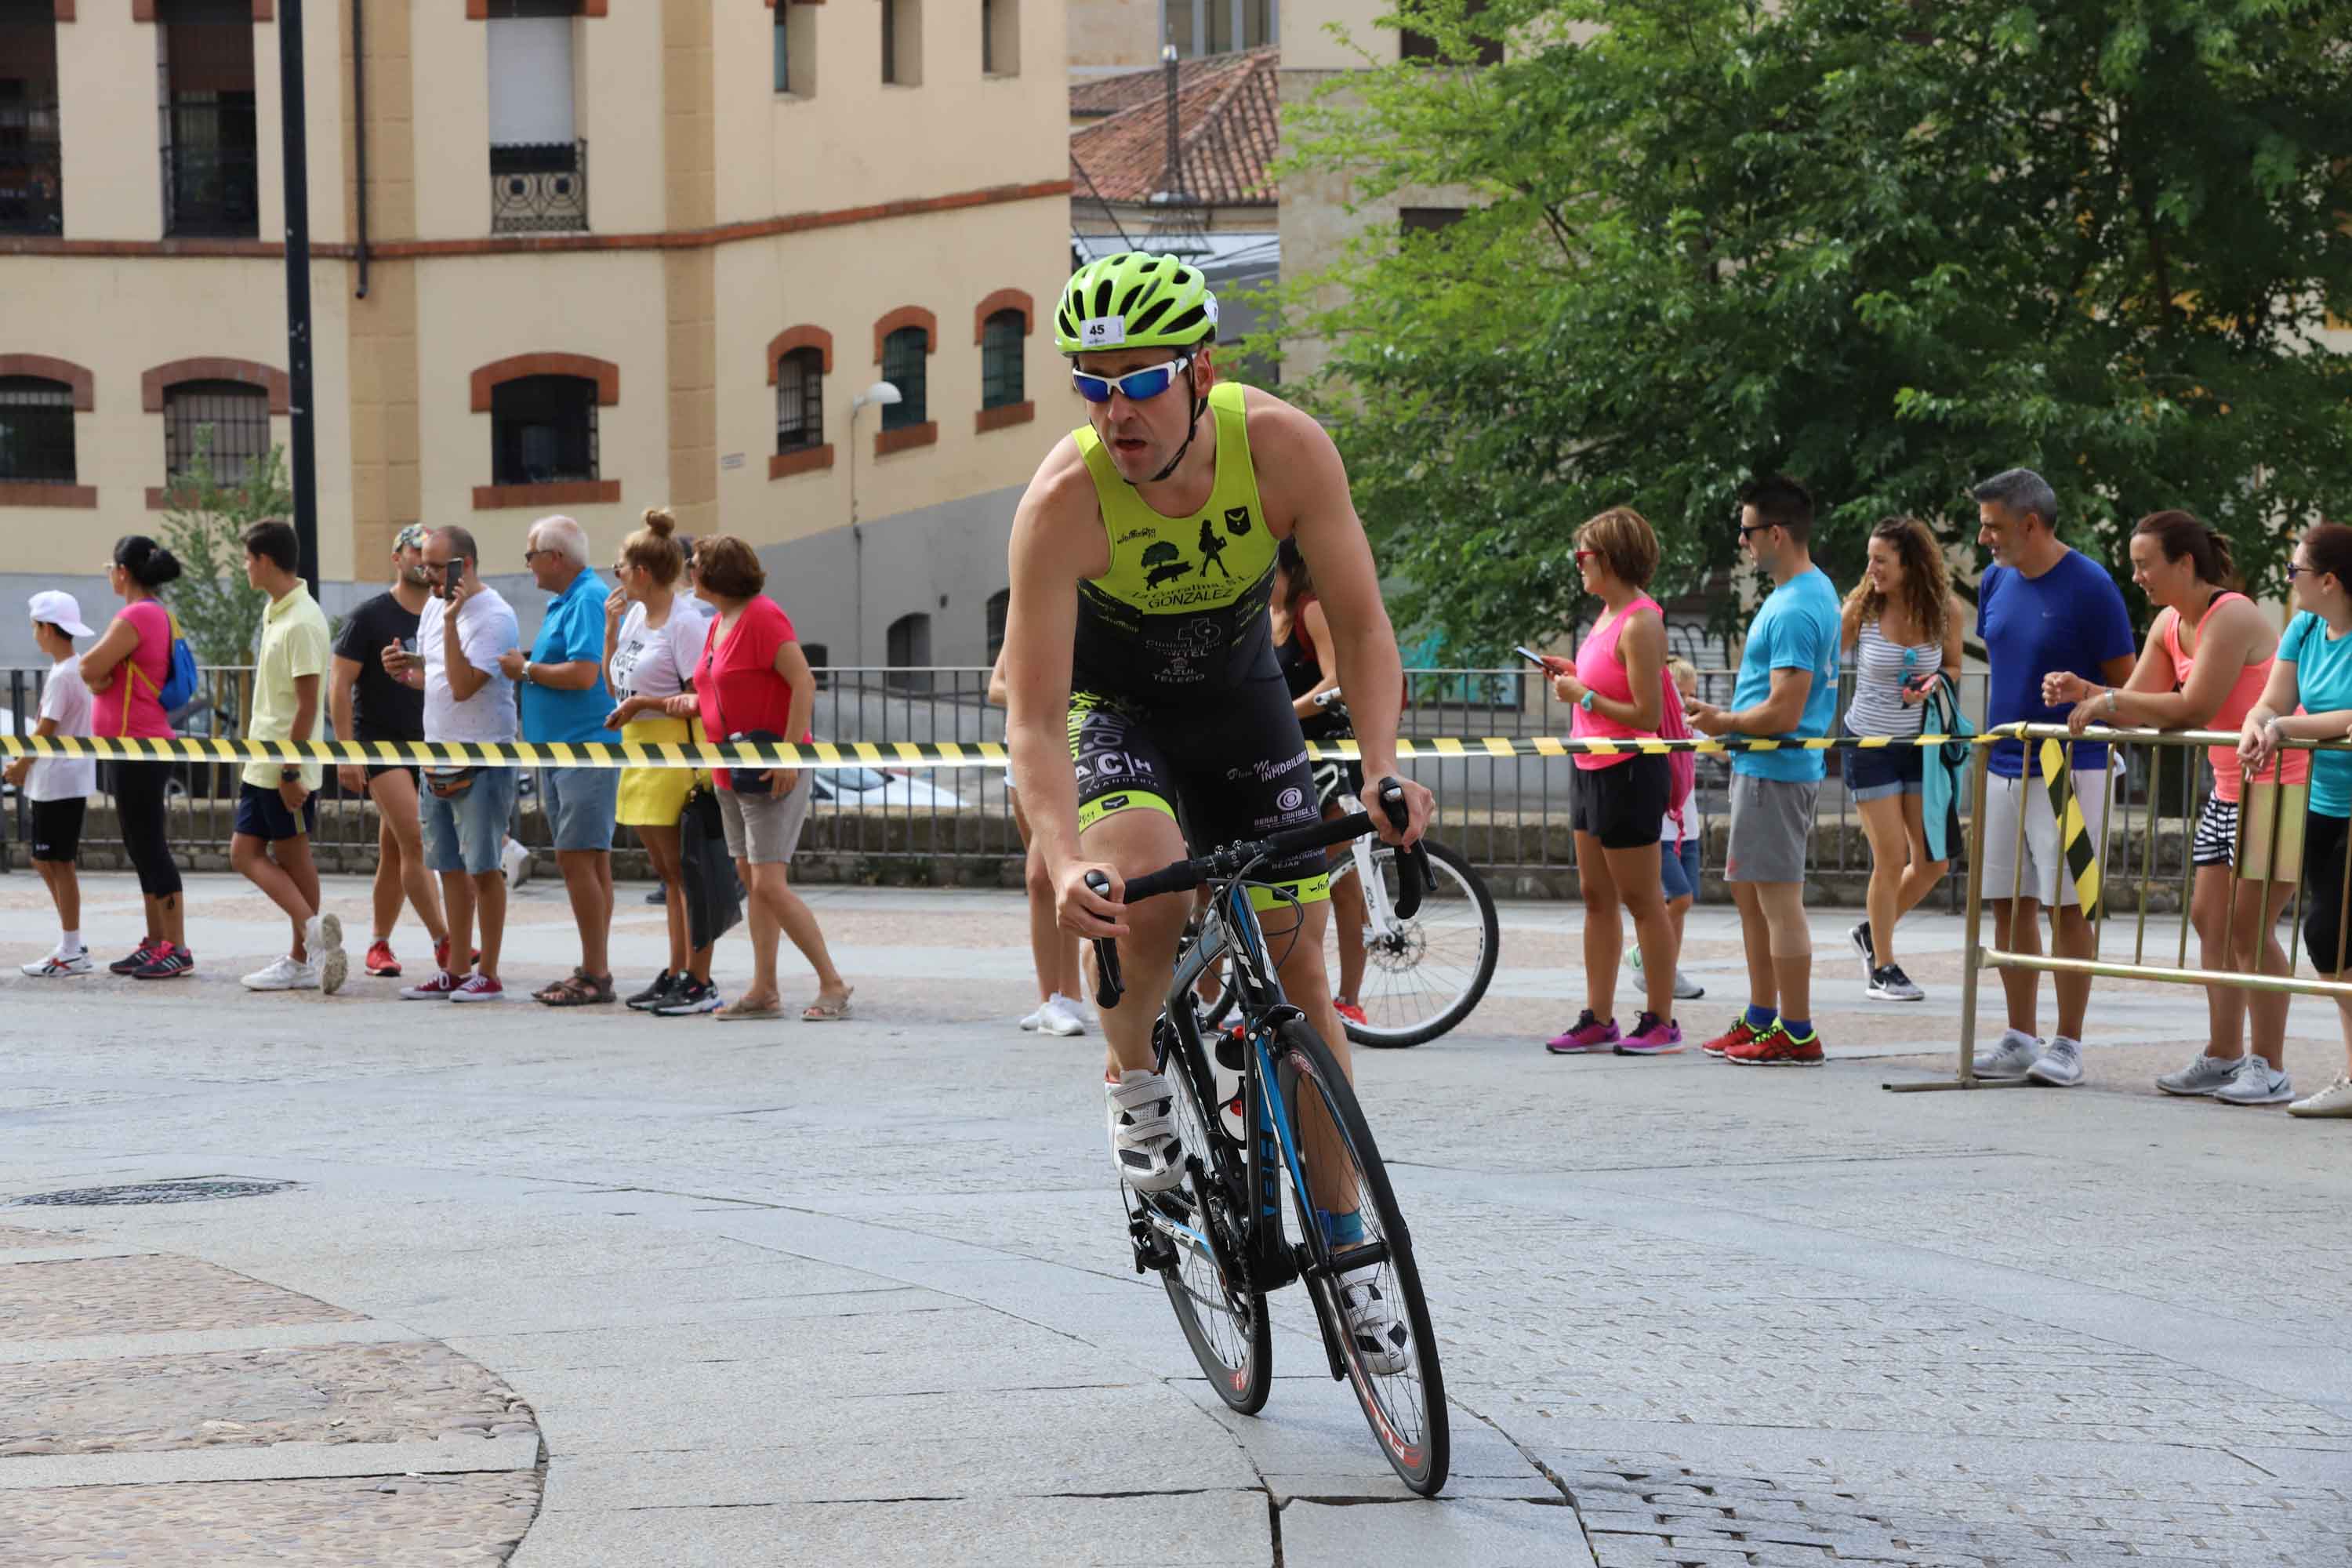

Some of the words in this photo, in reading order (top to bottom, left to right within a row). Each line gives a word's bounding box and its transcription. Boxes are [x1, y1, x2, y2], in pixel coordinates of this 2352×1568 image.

[1090, 324, 1105, 336] 45
[1148, 588, 1234, 609] GONZALEZ
[1223, 921, 1264, 989] BH
